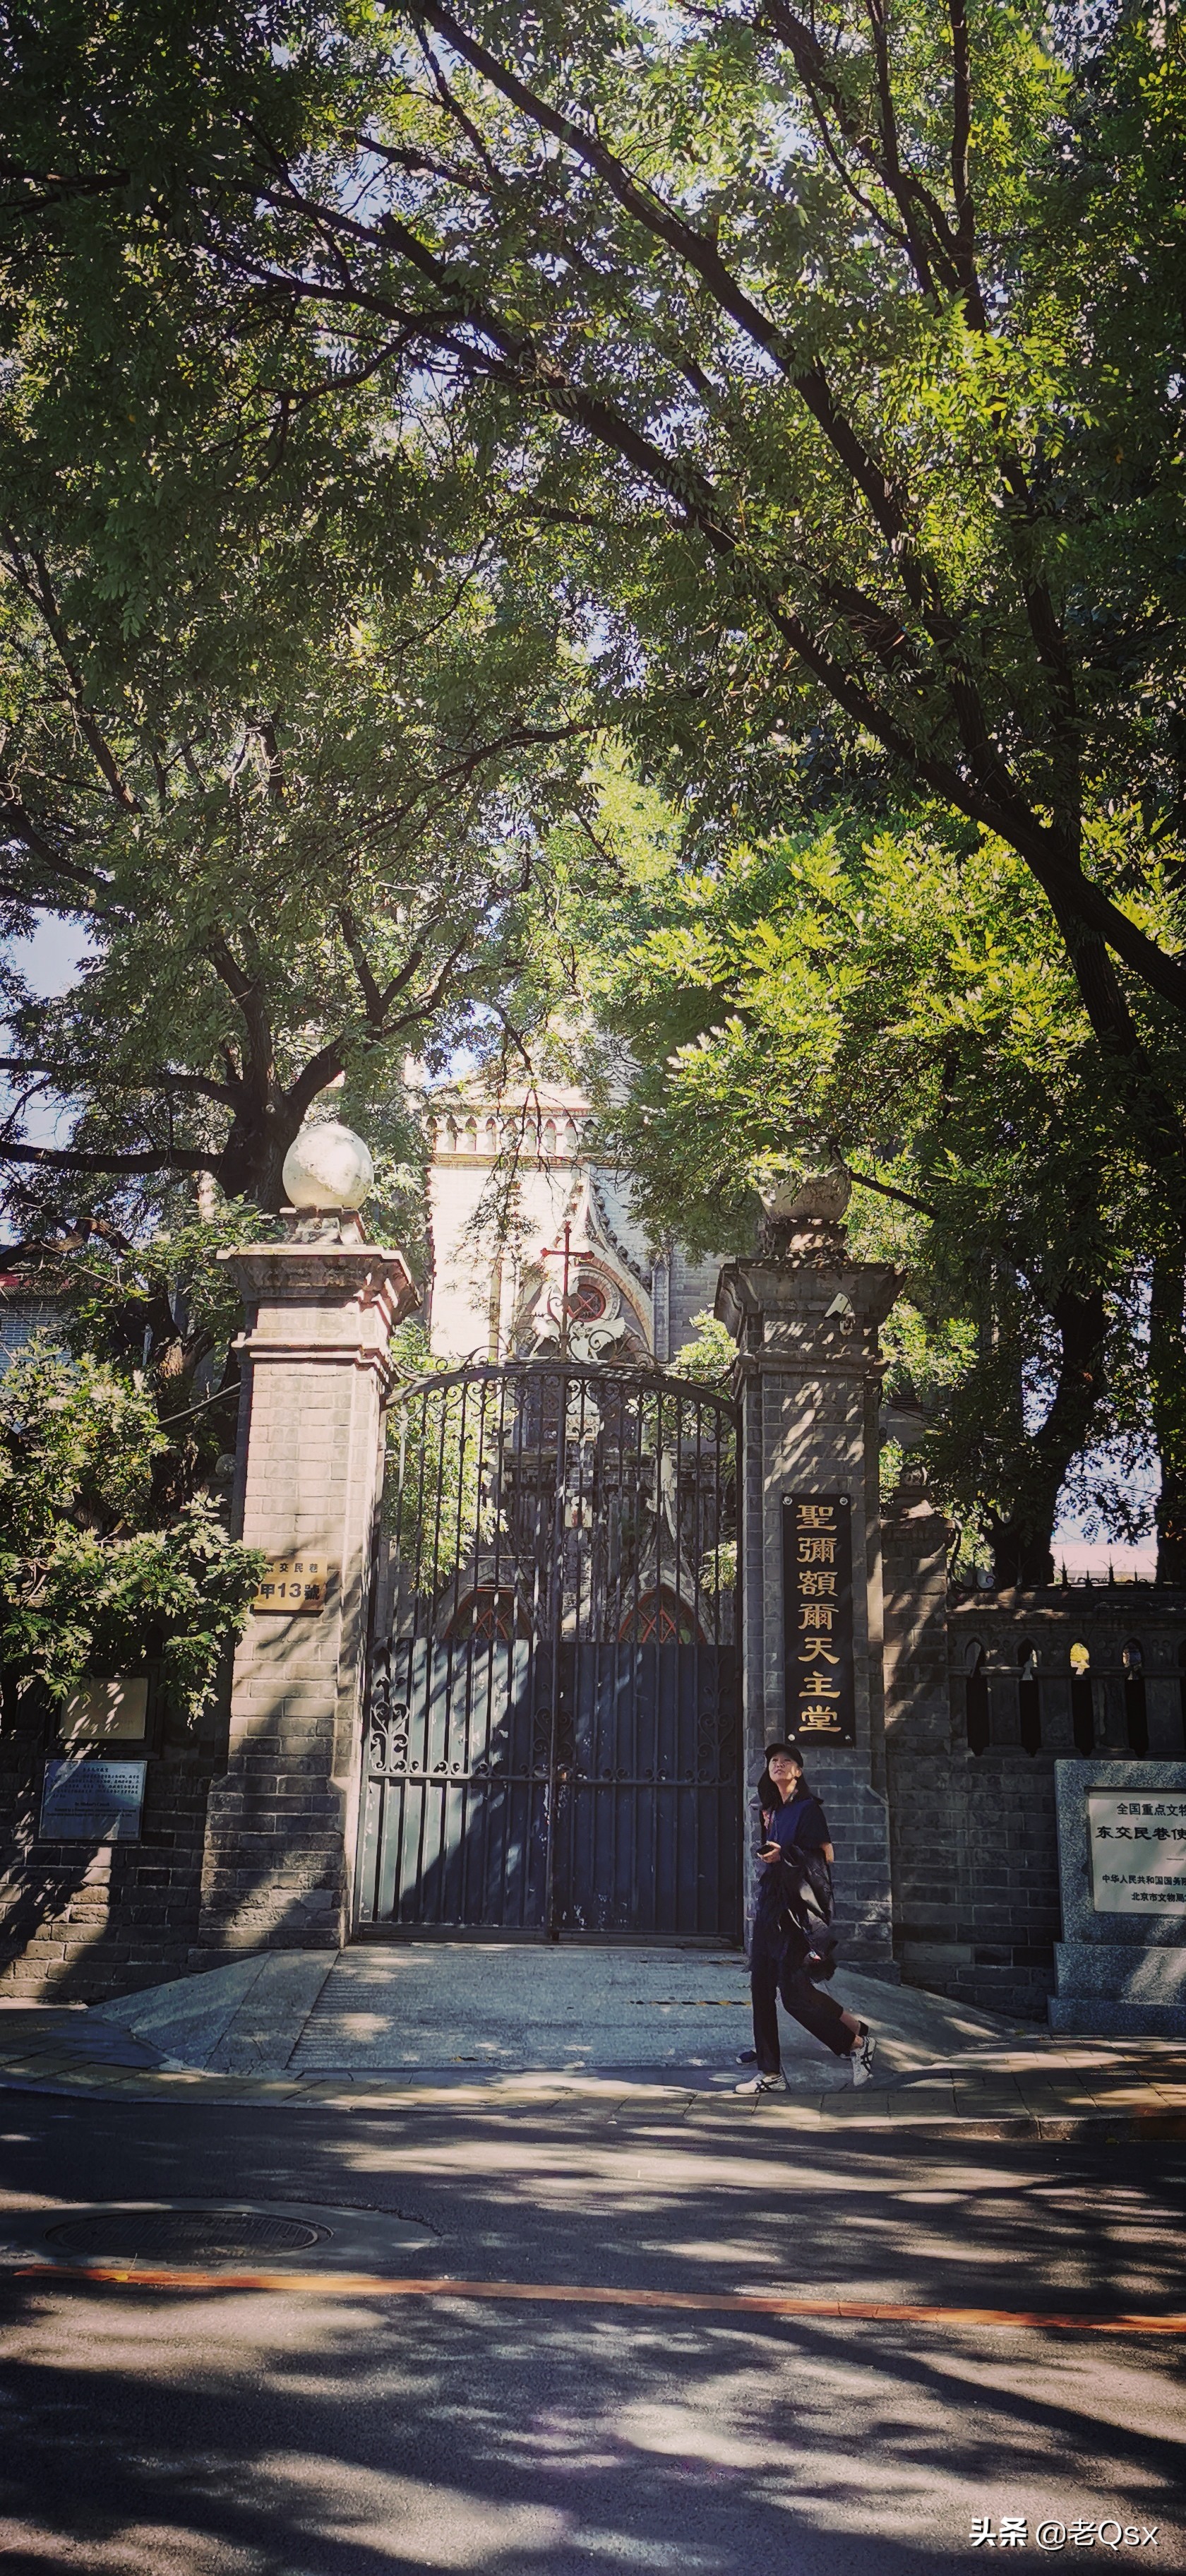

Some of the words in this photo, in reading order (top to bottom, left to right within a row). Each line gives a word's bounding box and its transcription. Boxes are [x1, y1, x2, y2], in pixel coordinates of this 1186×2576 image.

[260, 1582, 321, 1601] 甲13號
[796, 1504, 842, 1733] 聖彌額爾天主堂
[1116, 1802, 1186, 1817] 全国重点文物
[1095, 1825, 1186, 1841] 东交民巷使
[1131, 1892, 1186, 1903] 北京市文物局
